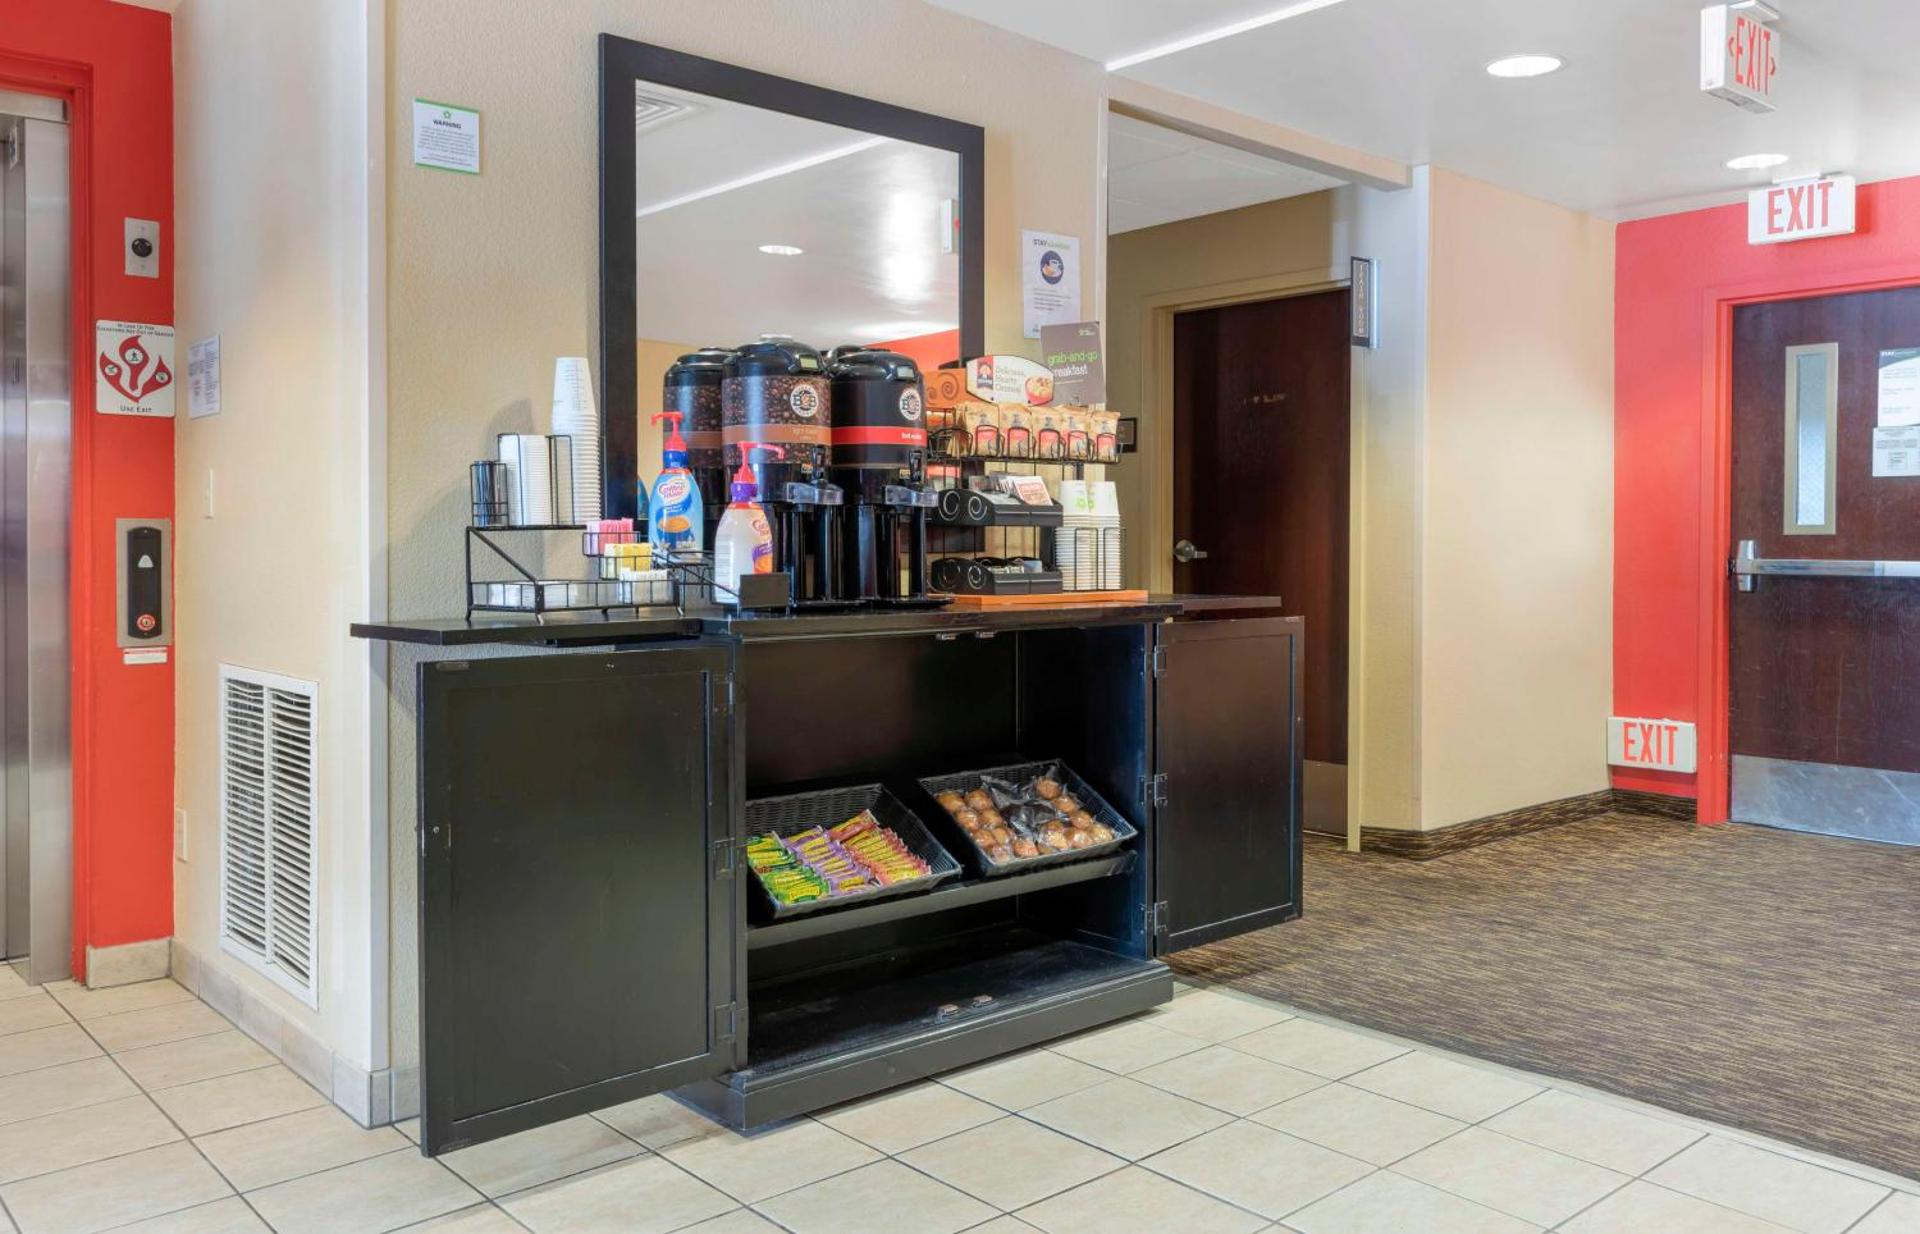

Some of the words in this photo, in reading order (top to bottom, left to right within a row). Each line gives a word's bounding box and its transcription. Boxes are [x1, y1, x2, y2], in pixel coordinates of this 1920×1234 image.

[1735, 16, 1771, 95] EXIT
[432, 119, 462, 129] WARNING
[1768, 182, 1834, 234] EXIT
[1623, 722, 1678, 766] EXIT
